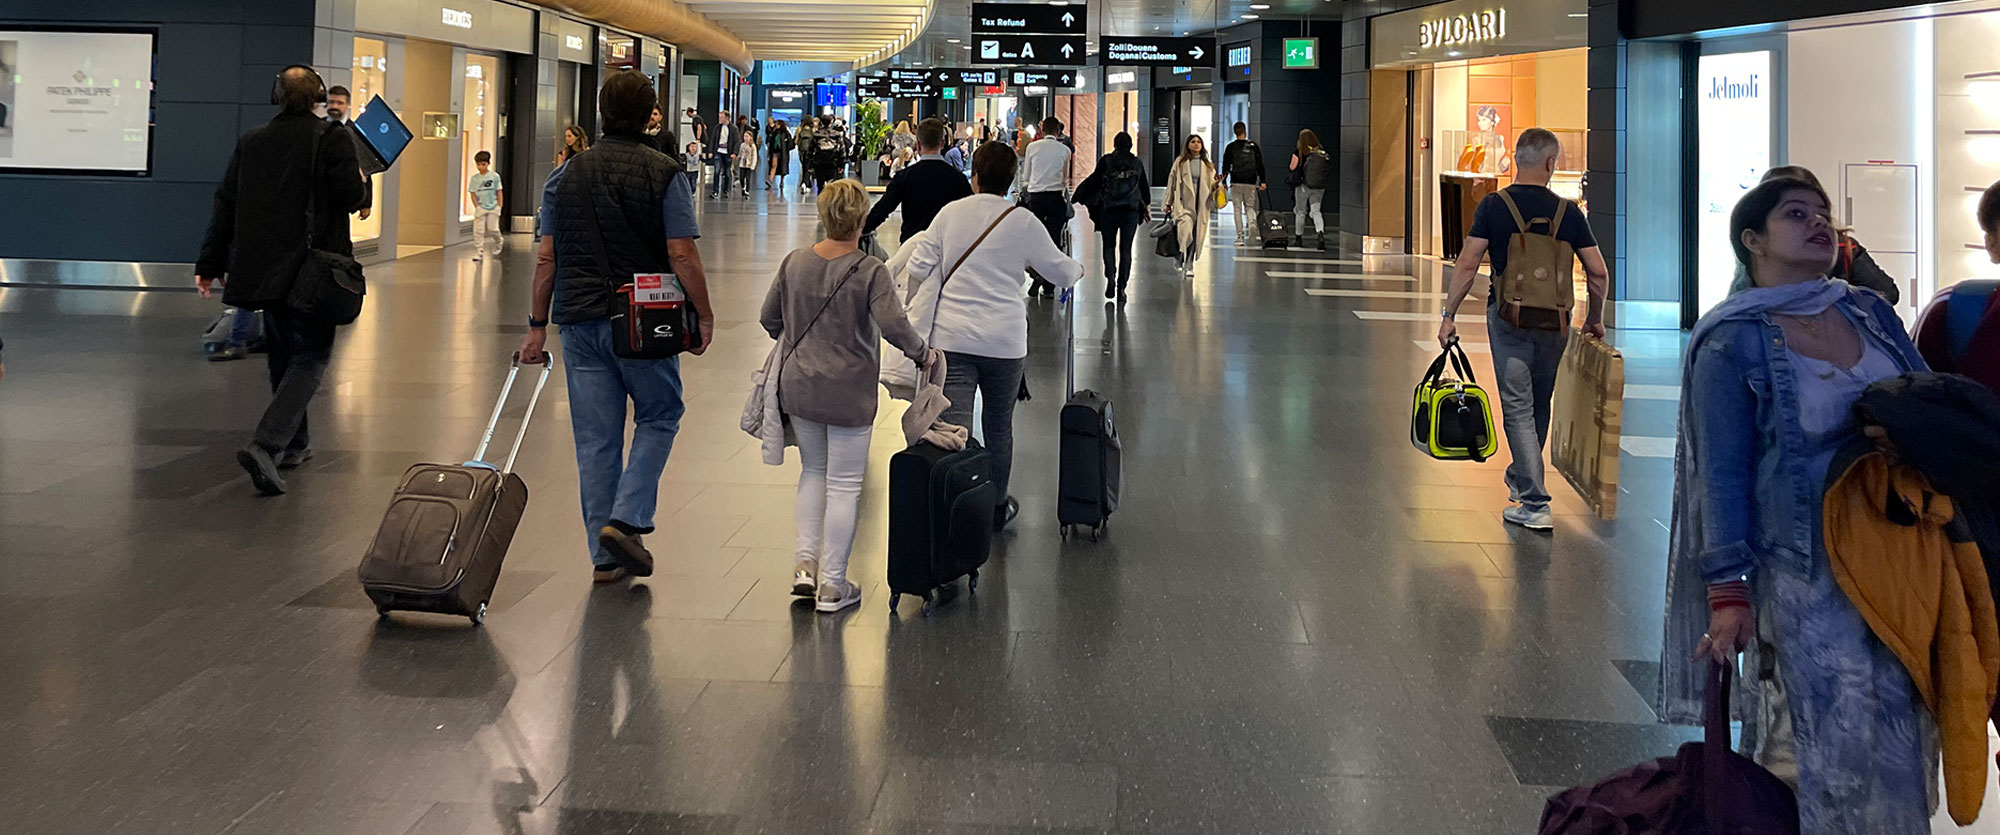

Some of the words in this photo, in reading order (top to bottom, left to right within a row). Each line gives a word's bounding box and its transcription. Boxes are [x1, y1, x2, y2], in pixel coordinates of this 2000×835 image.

[981, 18, 995, 26] Tax
[997, 18, 1026, 27] Refund
[1020, 42, 1035, 58] A
[1708, 73, 1759, 100] Jelmoli
